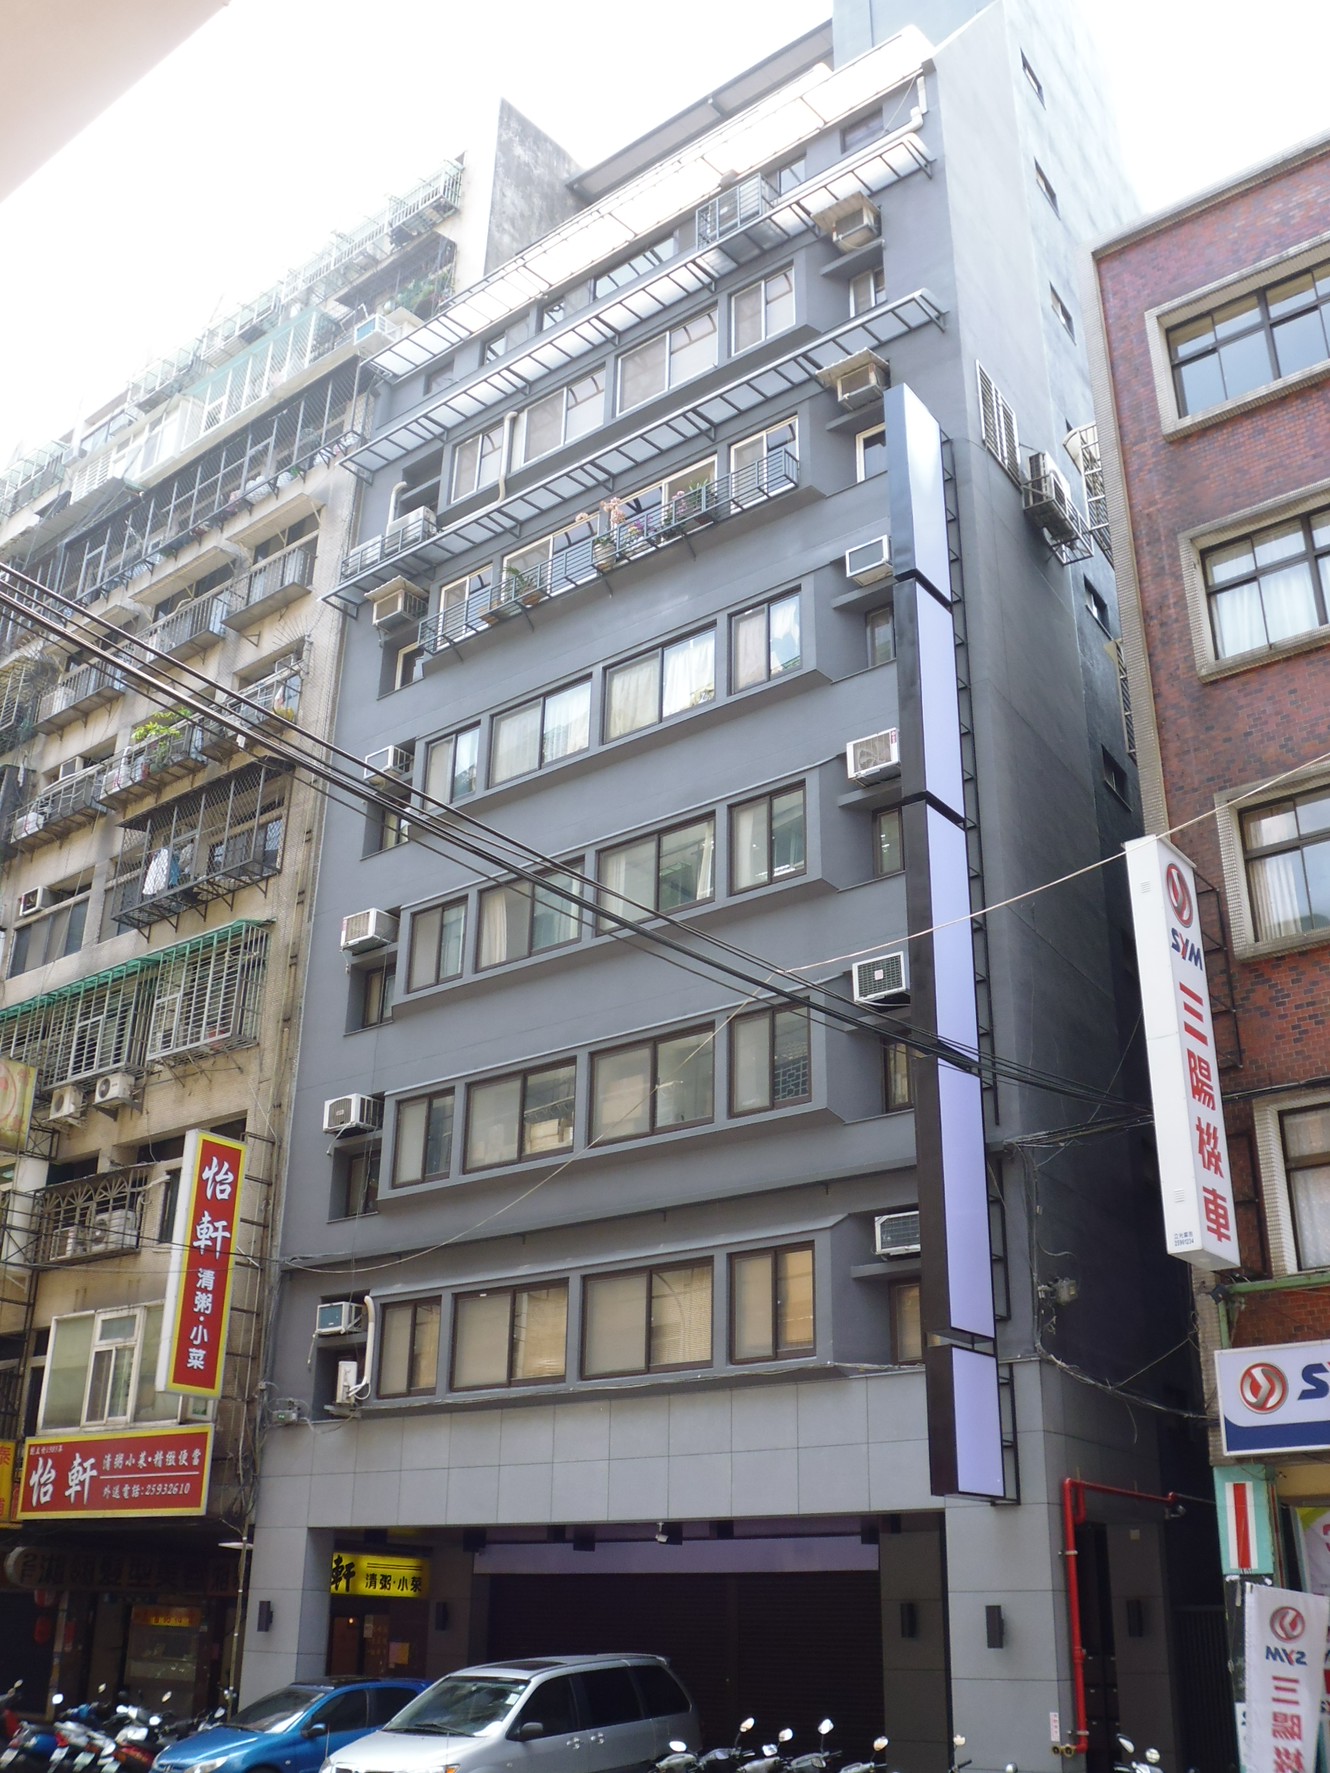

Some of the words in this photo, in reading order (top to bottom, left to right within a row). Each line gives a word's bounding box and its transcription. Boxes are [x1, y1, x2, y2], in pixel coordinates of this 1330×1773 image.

[1171, 927, 1203, 971] SYM
[1179, 981, 1232, 1243] 三陽機車
[192, 1156, 235, 1260] 怡軒
[1297, 1362, 1330, 1401] S
[29, 1453, 98, 1507] 怡軒
